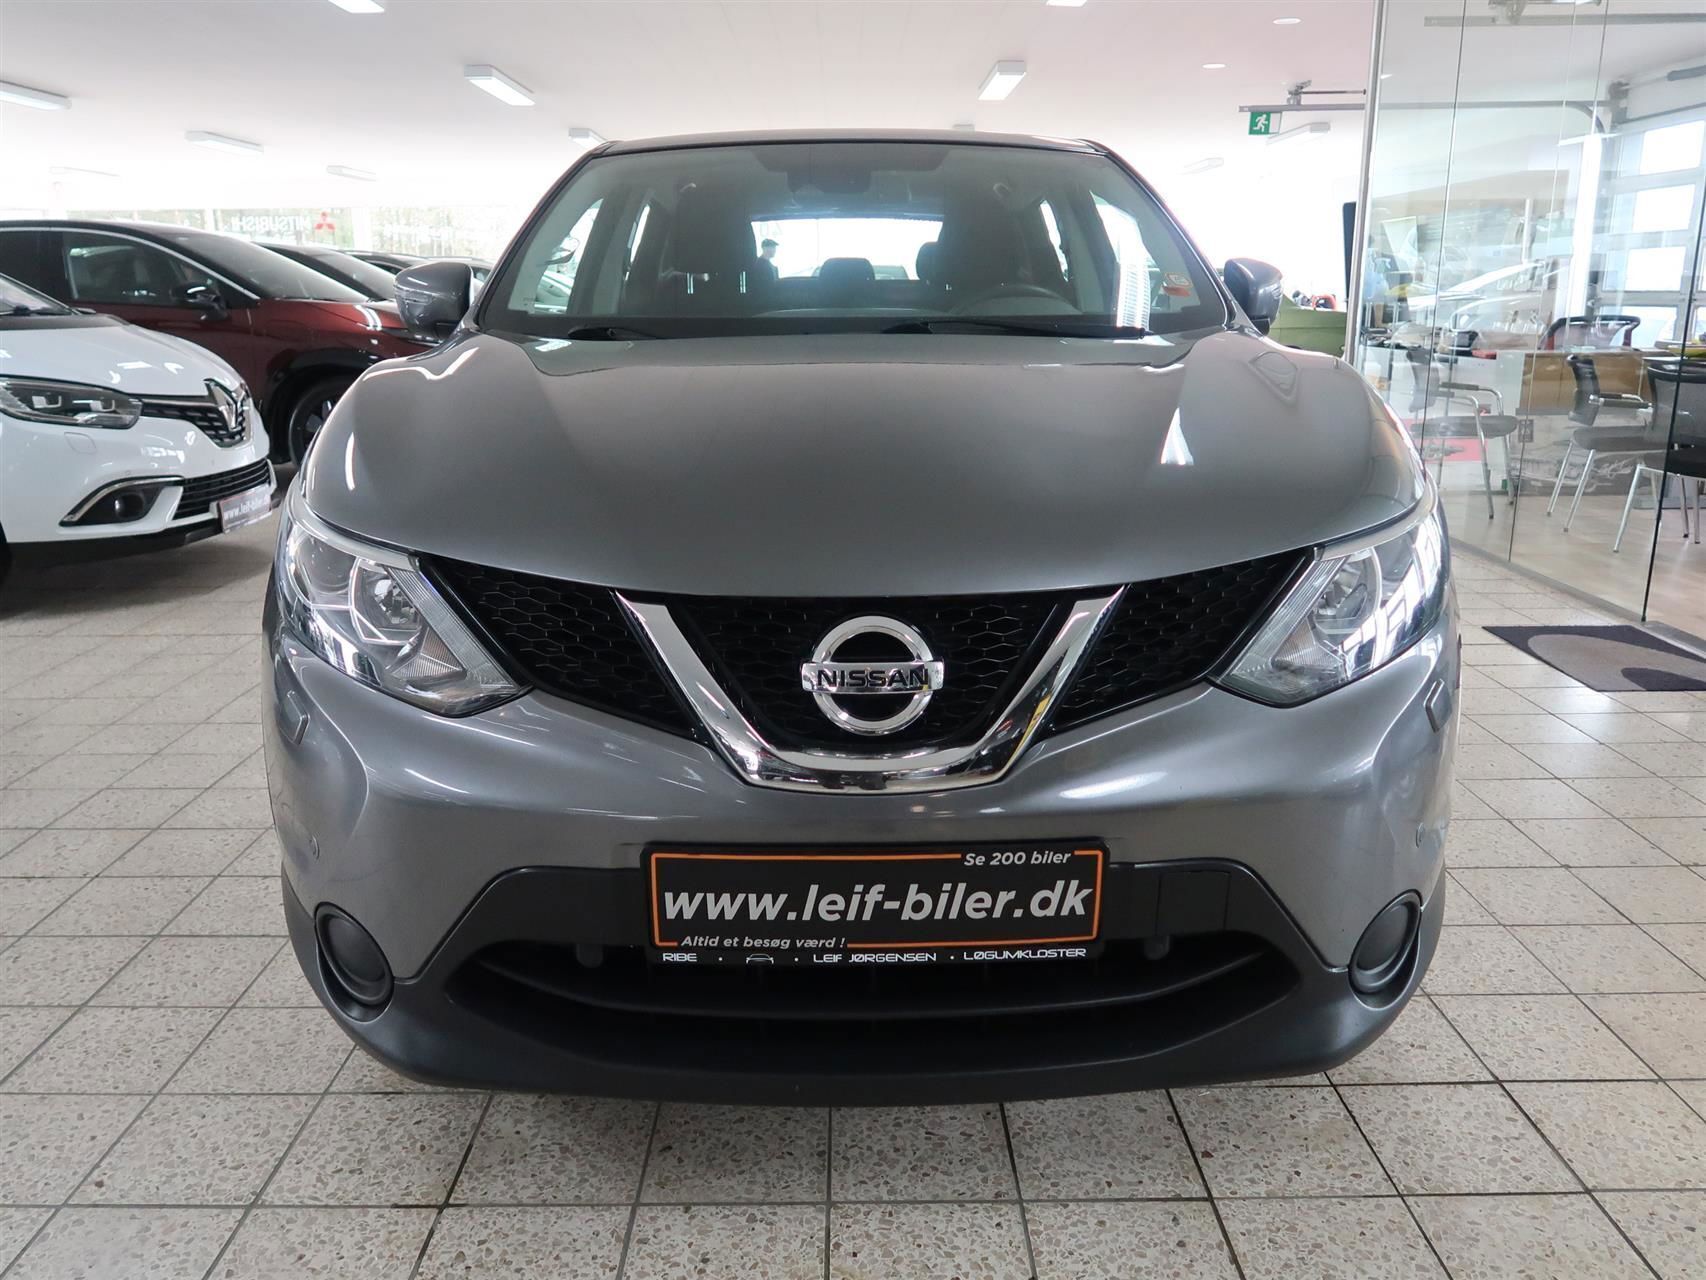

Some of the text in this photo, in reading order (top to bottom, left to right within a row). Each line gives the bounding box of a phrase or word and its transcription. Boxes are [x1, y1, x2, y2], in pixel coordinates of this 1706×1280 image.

[817, 669, 929, 688] NISSAN
[964, 851, 1071, 866] Se 200 biler
[664, 879, 1093, 922] www.leif-biler.dk
[681, 935, 719, 947] Altid
[723, 937, 739, 948] et
[743, 936, 791, 950] besøg
[796, 937, 836, 948] værd
[662, 948, 1087, 963] RIBE LEIF JØRGENSEN LØGUMKLOSTER
